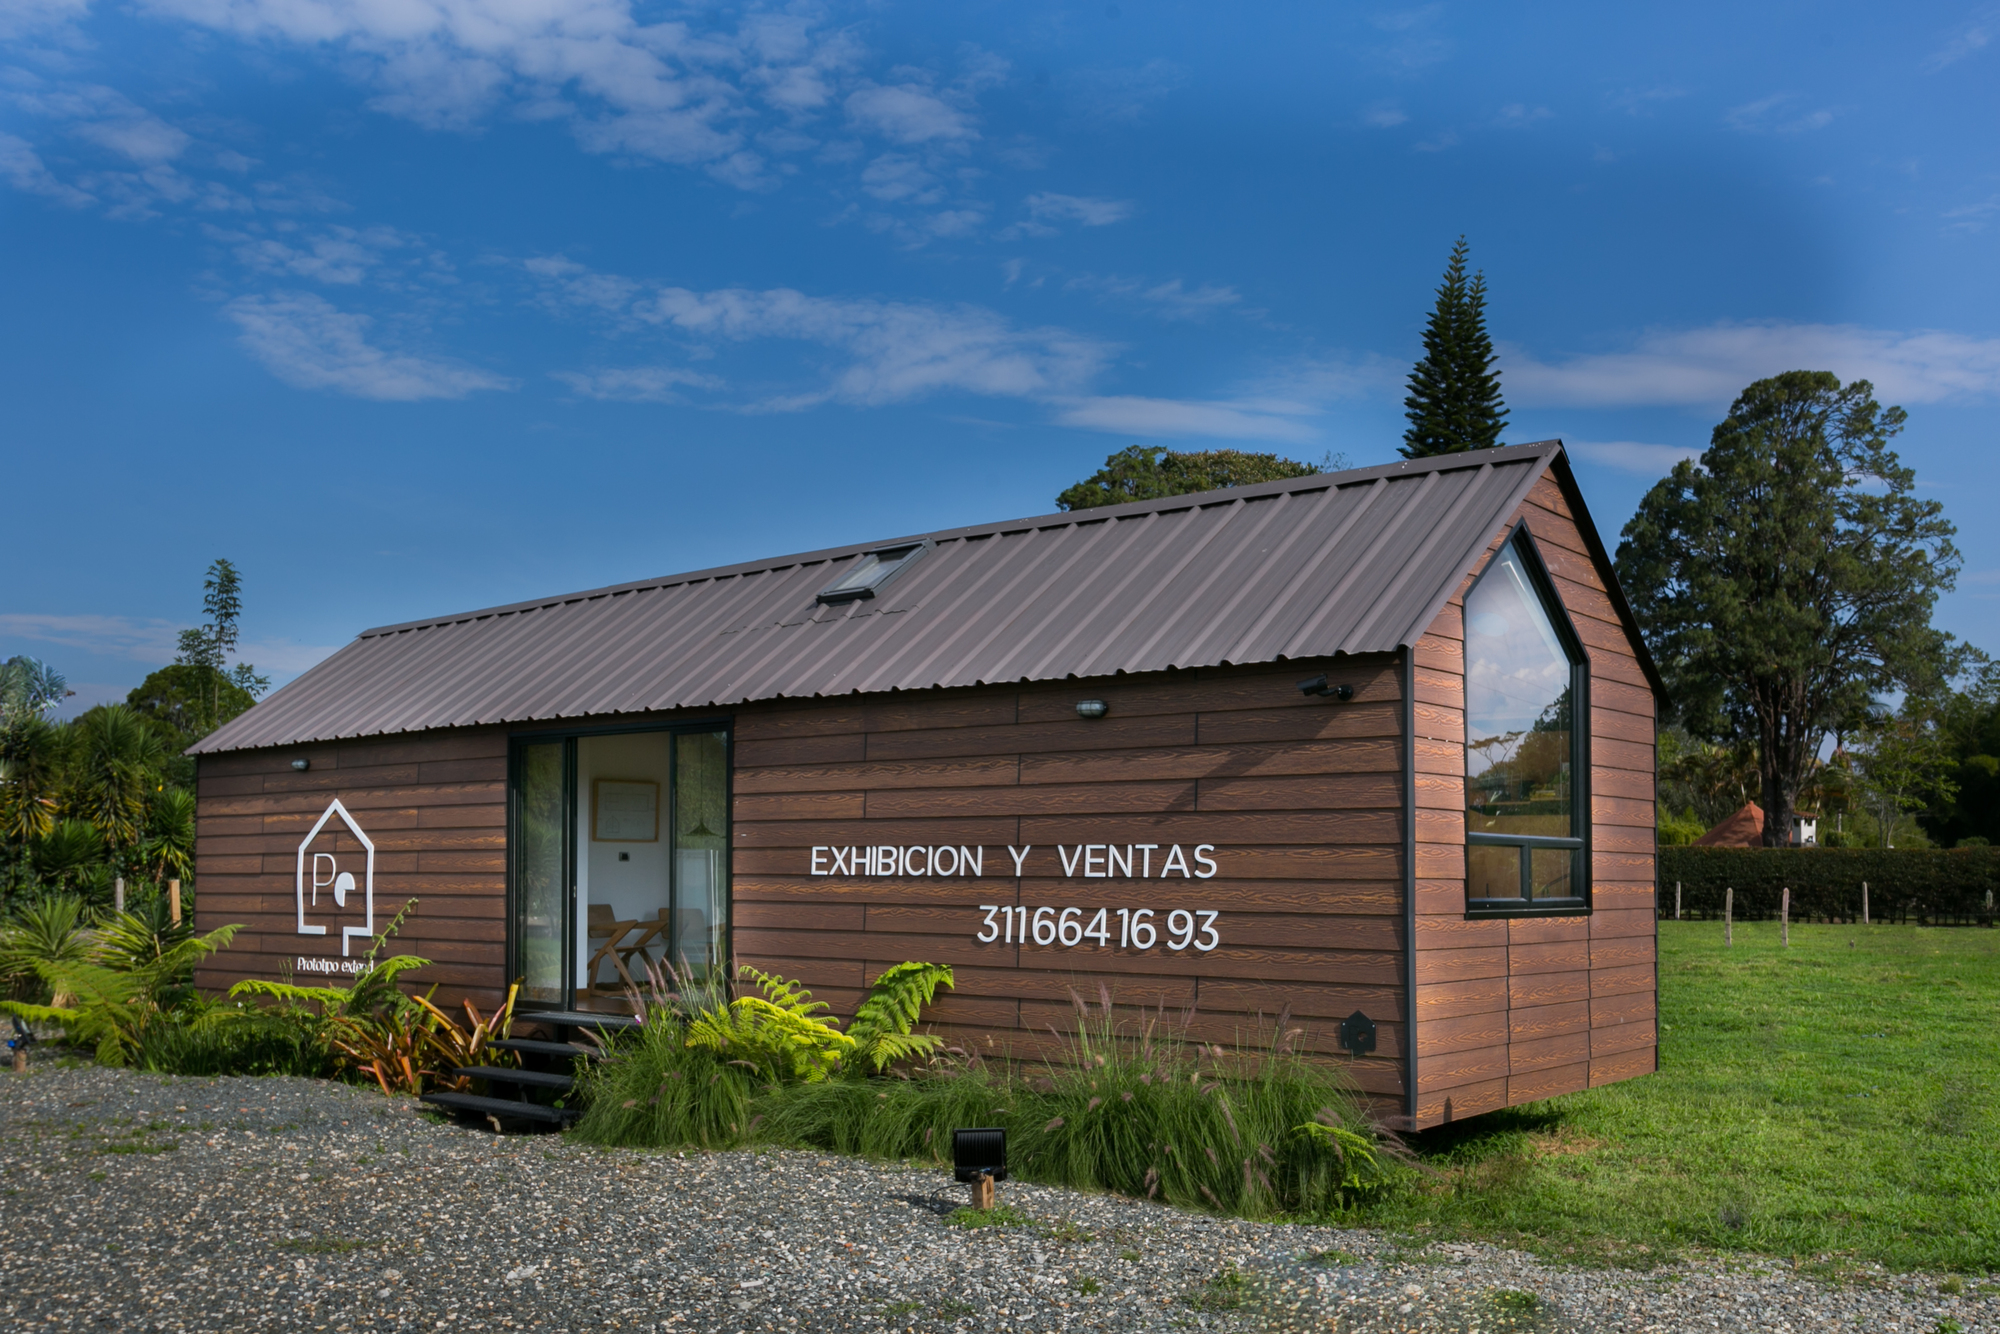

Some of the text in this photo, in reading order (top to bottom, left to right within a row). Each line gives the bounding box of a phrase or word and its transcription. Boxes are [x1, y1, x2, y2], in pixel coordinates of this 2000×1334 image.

[811, 844, 1219, 879] EXHIBICION Y VENTAS
[297, 957, 339, 974] Prototipo
